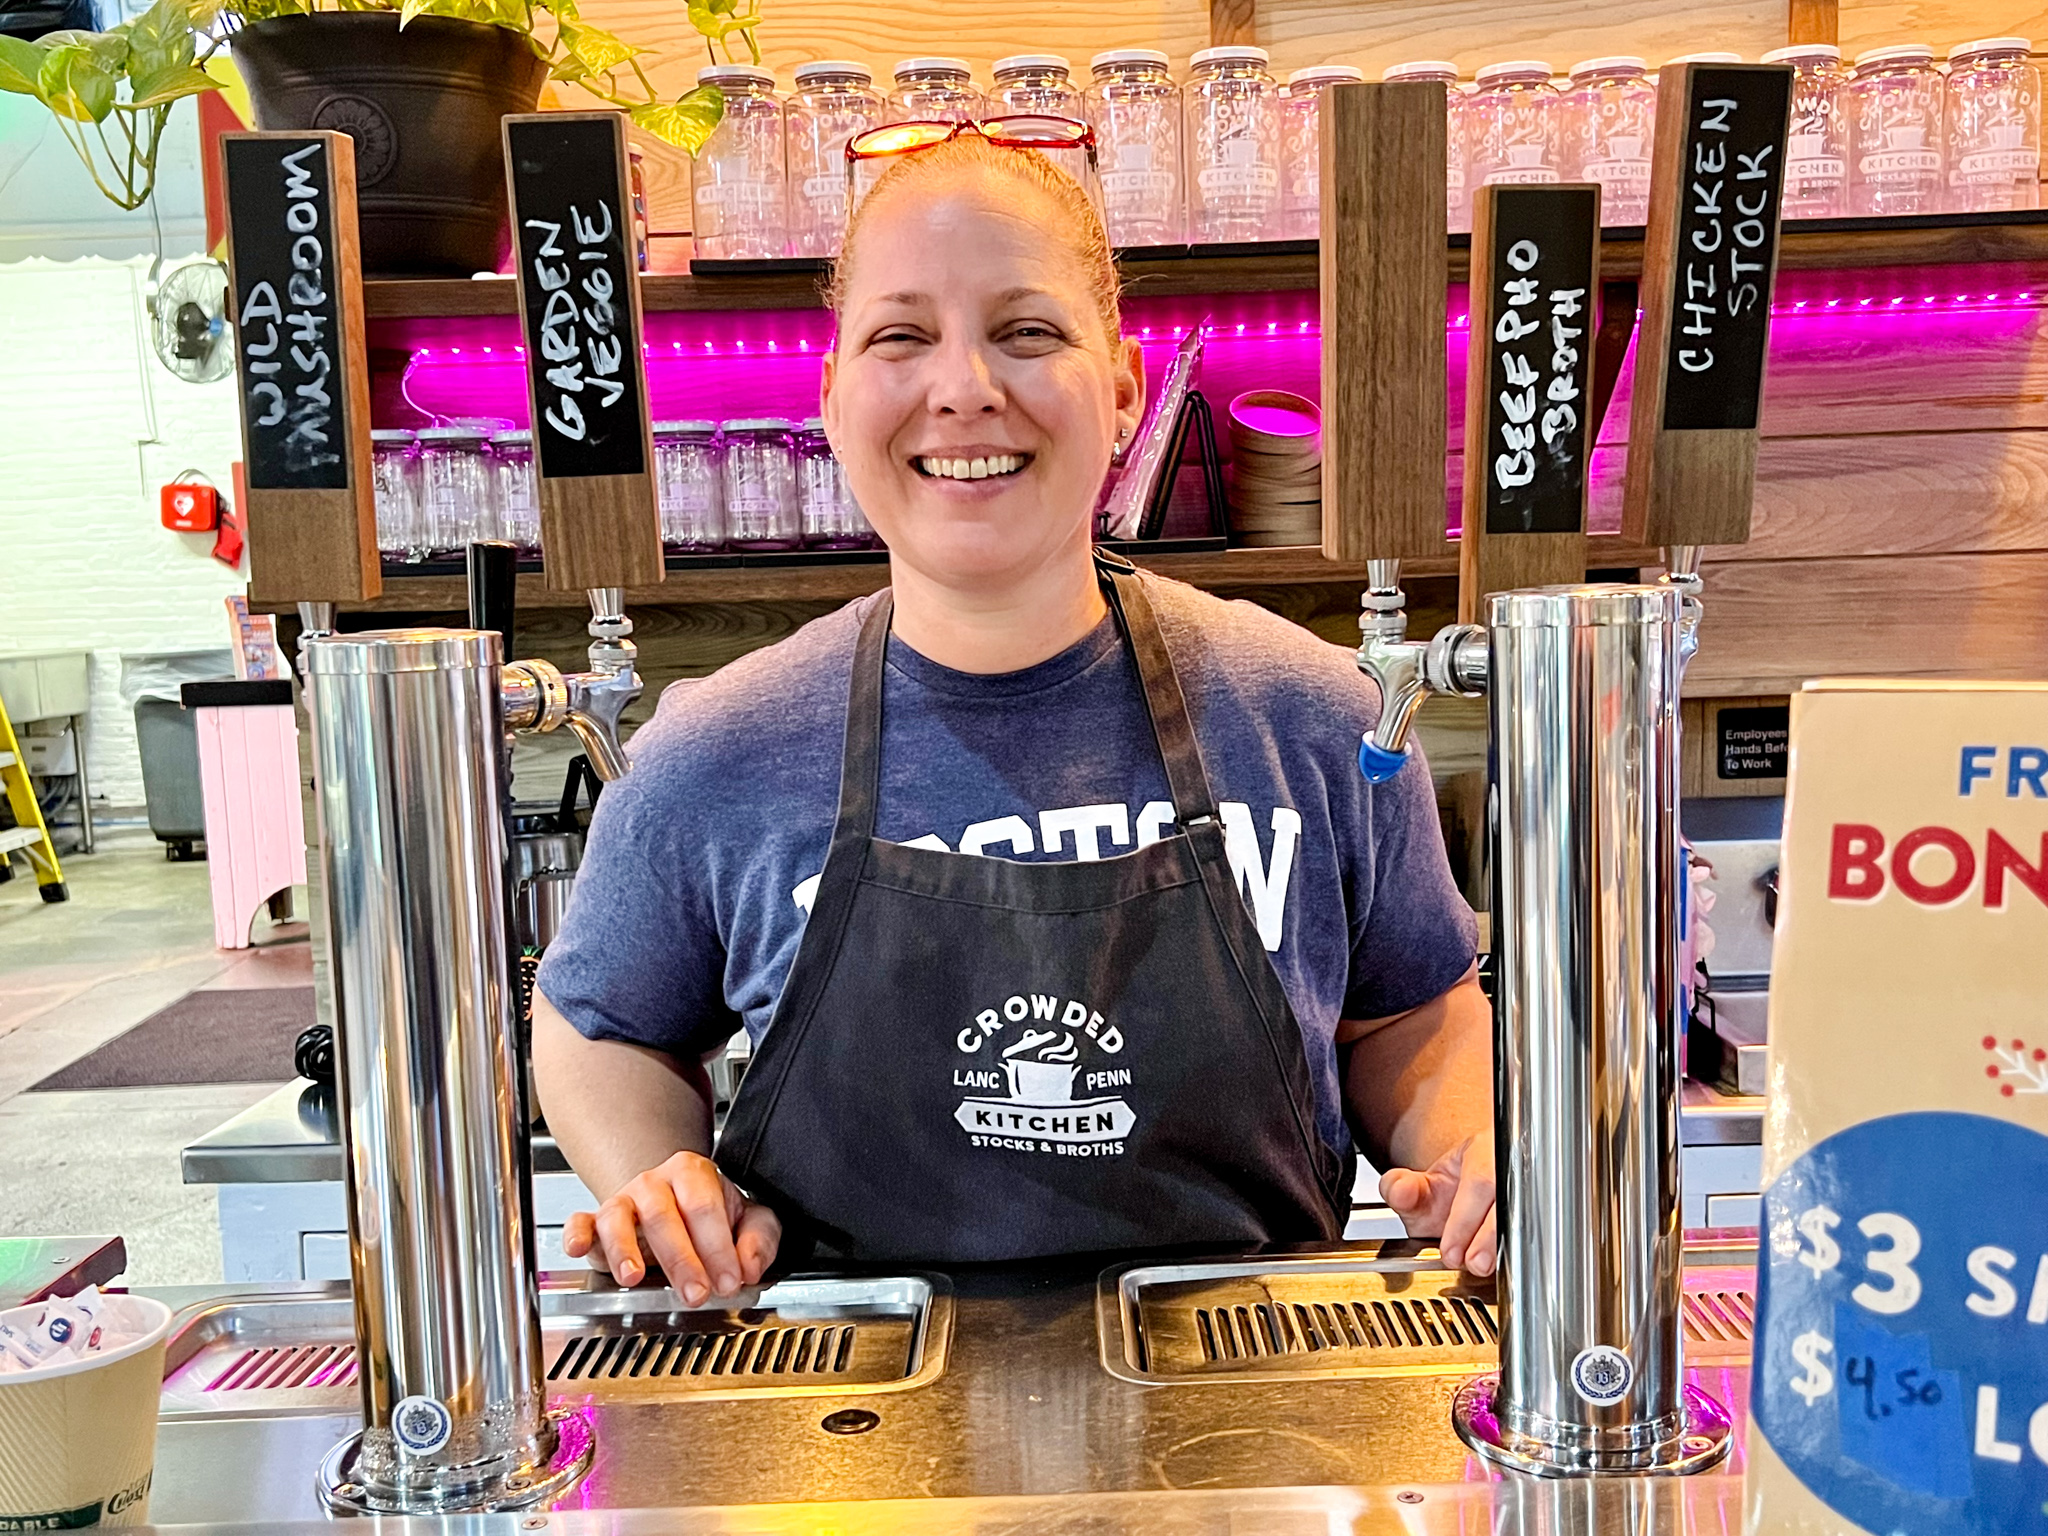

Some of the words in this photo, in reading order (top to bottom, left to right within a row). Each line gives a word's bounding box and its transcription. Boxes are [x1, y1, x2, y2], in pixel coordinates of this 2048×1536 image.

[1788, 164, 1839, 175] TCHEN
[1868, 156, 1937, 169] KITCHEN
[1679, 99, 1737, 372] CHICKEN
[1727, 145, 1773, 317] STOCK
[570, 200, 624, 407] VEGGIE
[1495, 240, 1539, 342] PHO
[525, 219, 586, 440] GARDEN
[241, 281, 284, 426] WILD
[1541, 288, 1585, 444] BROTH
[1495, 351, 1539, 489] BEEF
[1726, 729, 1787, 741] Employees
[1726, 743, 1761, 755] Hands
[1726, 758, 1739, 769] To
[1742, 758, 1772, 769] Work
[957, 994, 1124, 1053] CROWDED
[954, 1069, 1000, 1089] LANC
[1086, 1068, 1131, 1090] PENN
[976, 1110, 1113, 1133] KITCHEN
[971, 1135, 1035, 1151] STOCKS
[1040, 1141, 1052, 1152] &
[1057, 1141, 1125, 1157] BROTHS
